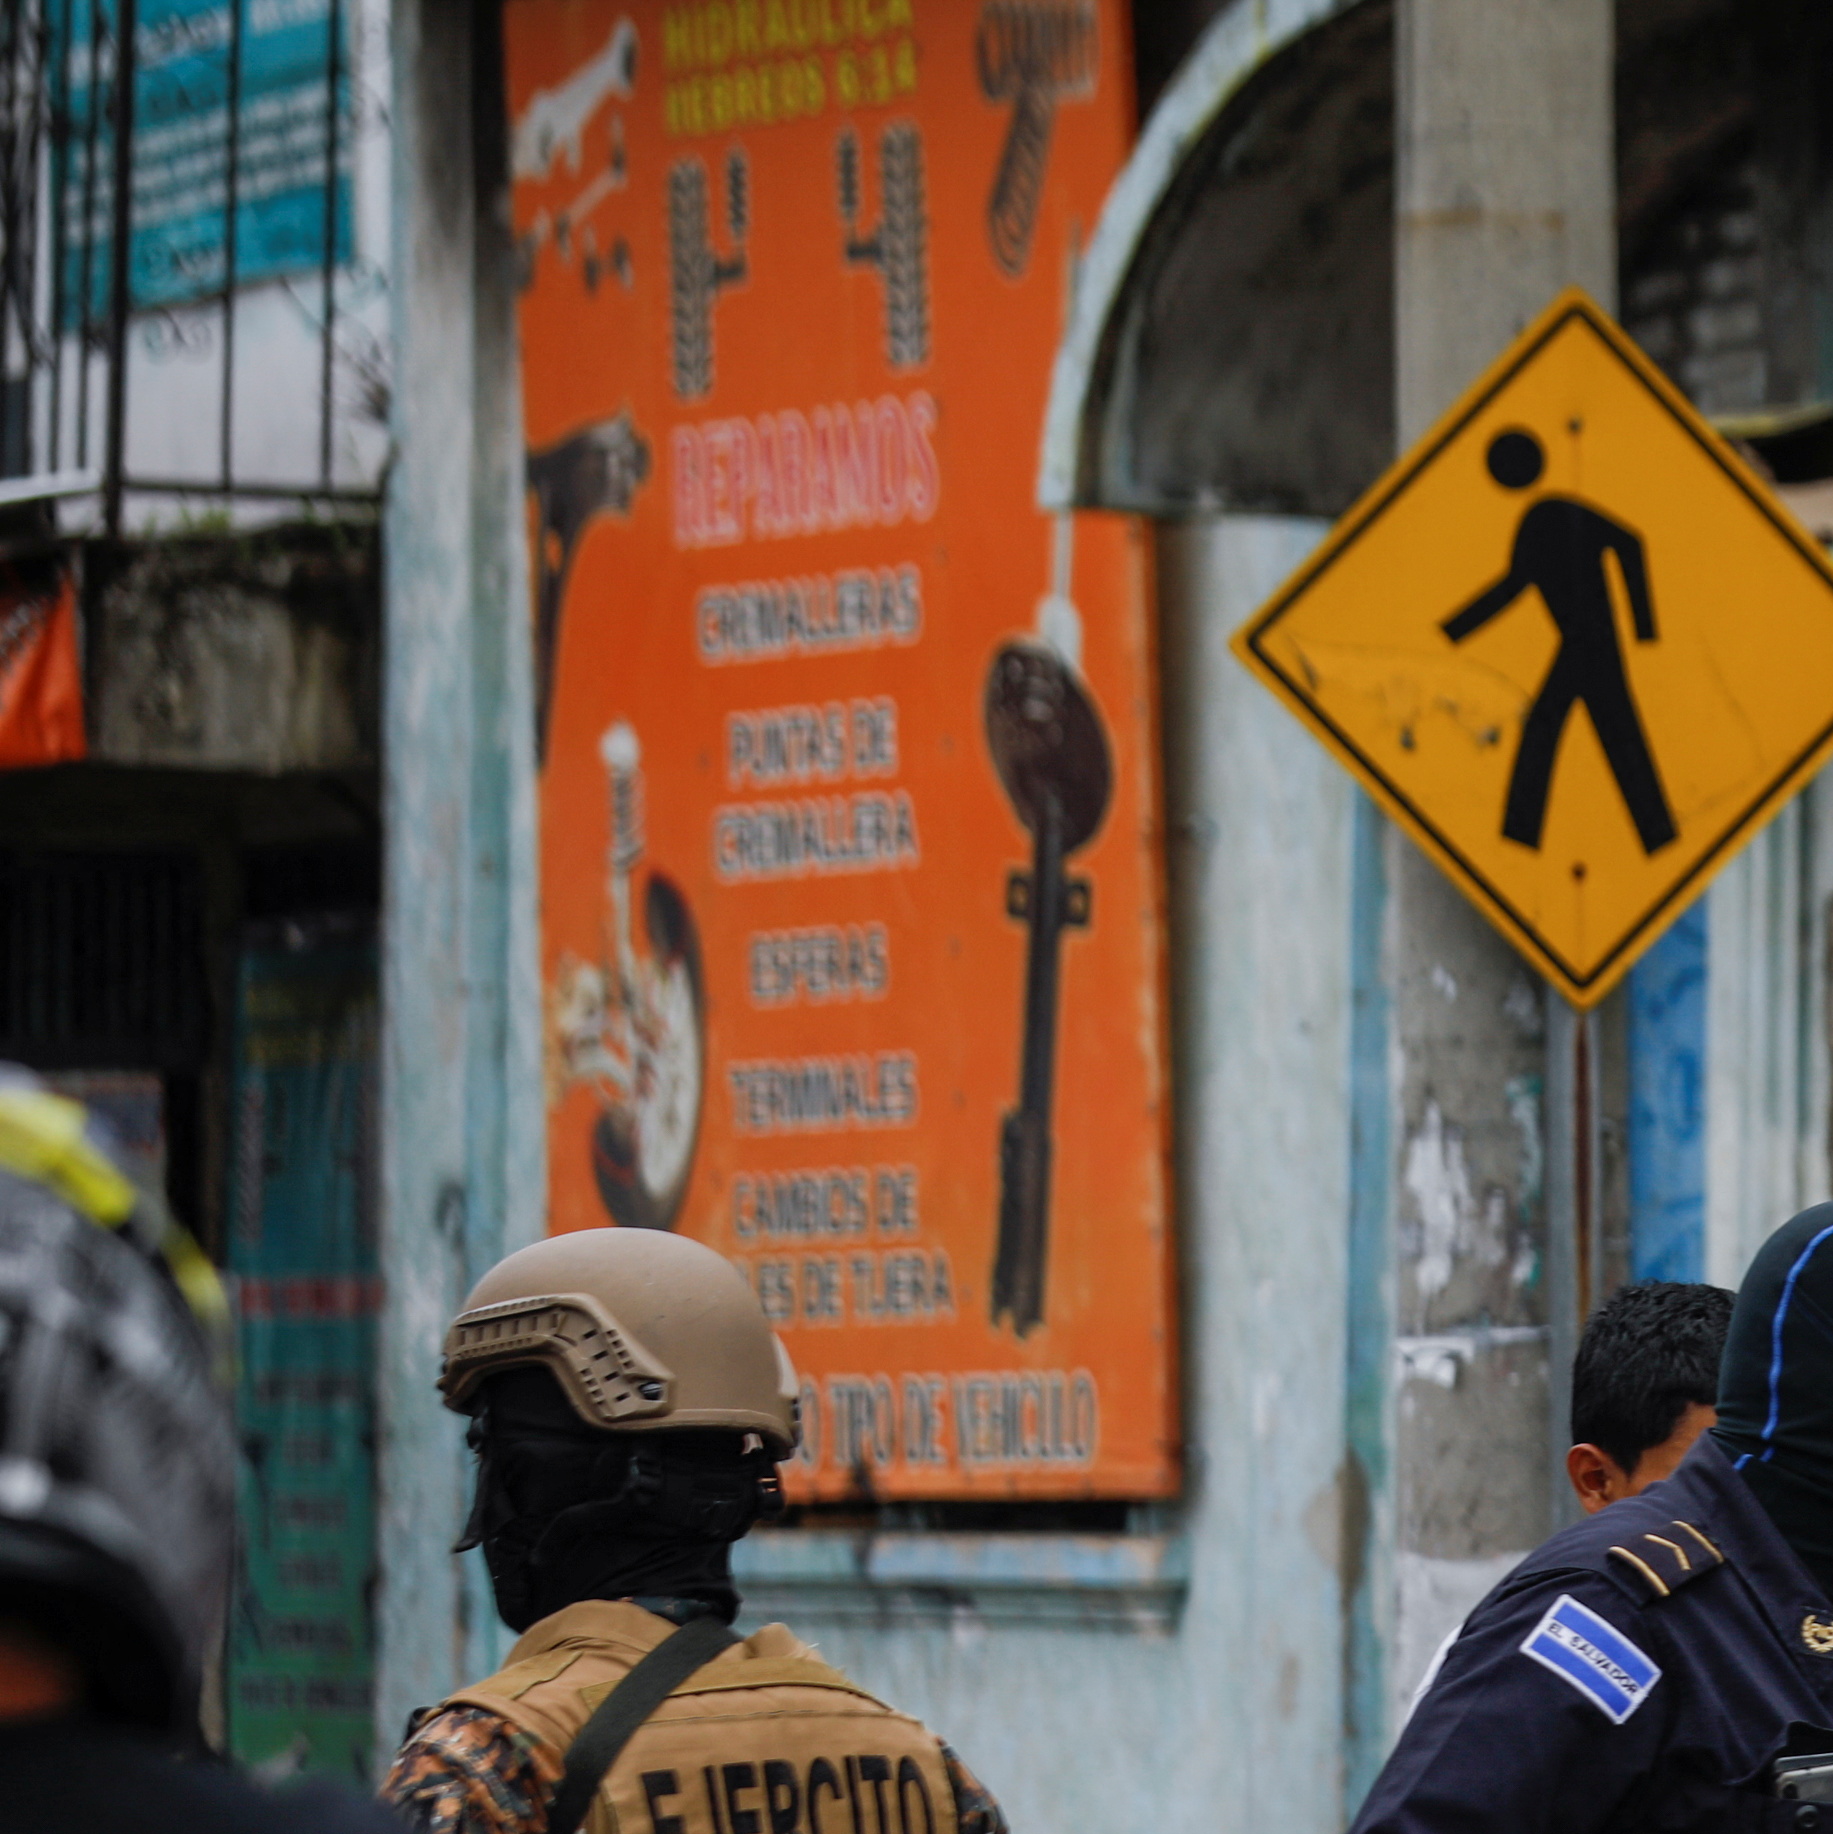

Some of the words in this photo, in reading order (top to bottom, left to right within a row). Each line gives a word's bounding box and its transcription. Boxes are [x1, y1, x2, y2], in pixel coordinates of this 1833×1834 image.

[671, 392, 940, 550] REPARAMOS
[697, 563, 923, 666] CREMALLERAS
[726, 702, 847, 790] PUNTAS
[851, 696, 897, 779] DE
[714, 789, 919, 885] CREMALLERA
[750, 921, 889, 1006] ESFERAS
[728, 1050, 919, 1137] TERMINALES
[734, 1166, 870, 1248] CAMBIOS
[873, 1164, 919, 1242] DE
[801, 1252, 842, 1328] DE
[902, 1371, 949, 1470] DE
[953, 1367, 1098, 1471] VEHICULO
[1547, 1622, 1564, 1640] EL
[1569, 1635, 1639, 1694] SALVADOR
